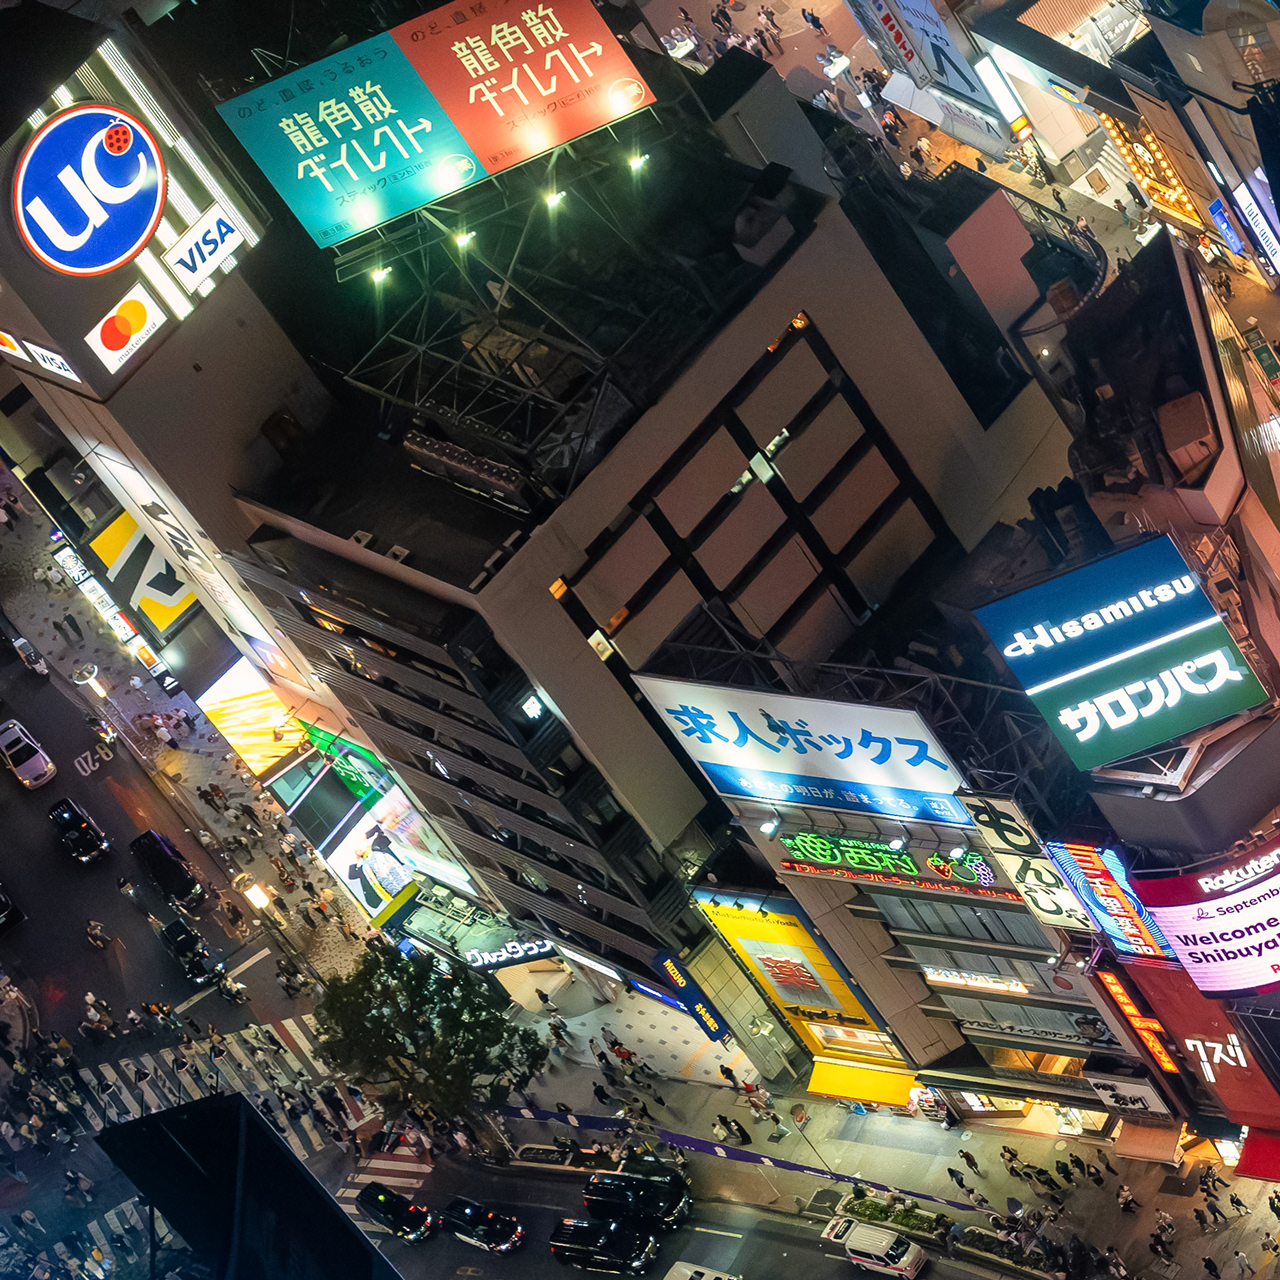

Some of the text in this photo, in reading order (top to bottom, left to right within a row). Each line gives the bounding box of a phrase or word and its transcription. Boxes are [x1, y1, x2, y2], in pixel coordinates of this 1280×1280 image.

[451, 3, 570, 79] 龍角散
[469, 41, 603, 117] ダイレクト
[278, 80, 398, 154] 龍角散
[297, 118, 432, 193] ダイレクト
[174, 217, 236, 275] VISA
[32, 350, 74, 375] VISA
[117, 321, 158, 364] mastercard
[1003, 575, 1196, 657] Hisamitsu
[1058, 650, 1243, 742] サロンパス
[664, 704, 948, 771] 求人ボックス
[1069, 849, 1155, 956] 三千里薬品
[1176, 914, 1280, 947] Welcome
[465, 940, 552, 967] グルメタウン
[663, 959, 687, 987] MIZUHO
